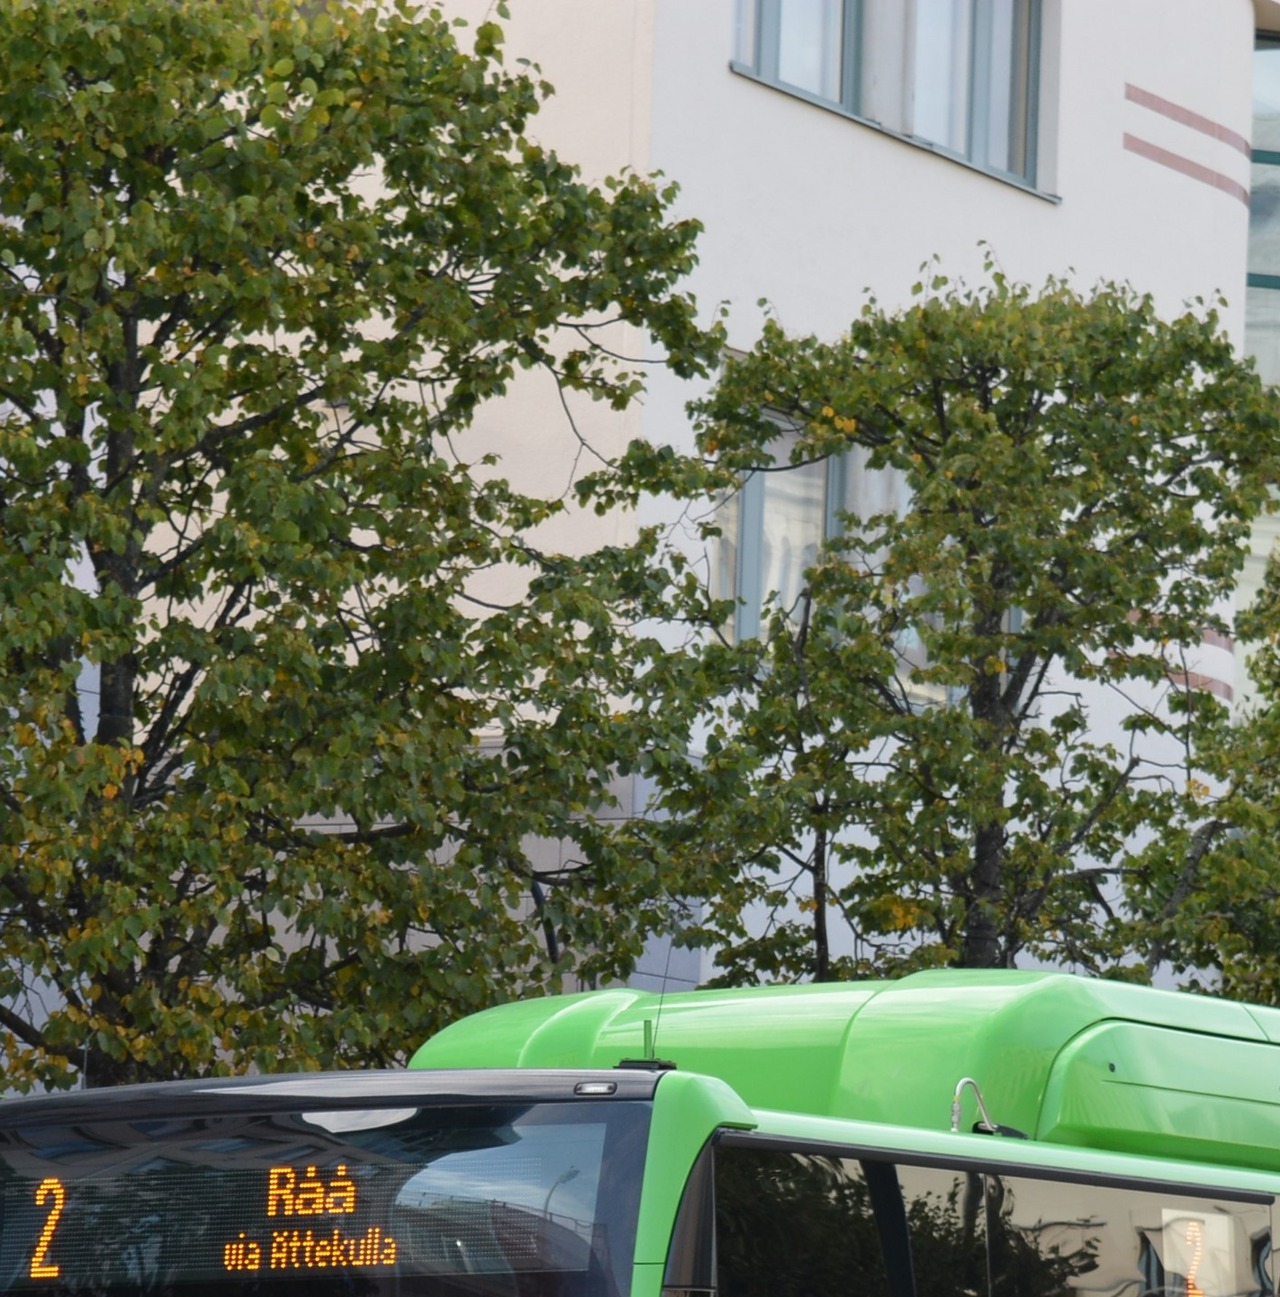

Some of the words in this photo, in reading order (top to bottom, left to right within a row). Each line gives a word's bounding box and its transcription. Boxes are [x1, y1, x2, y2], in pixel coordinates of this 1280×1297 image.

[267, 1164, 356, 1216] Råå
[30, 1178, 64, 1277] 2
[223, 1232, 261, 1270] via
